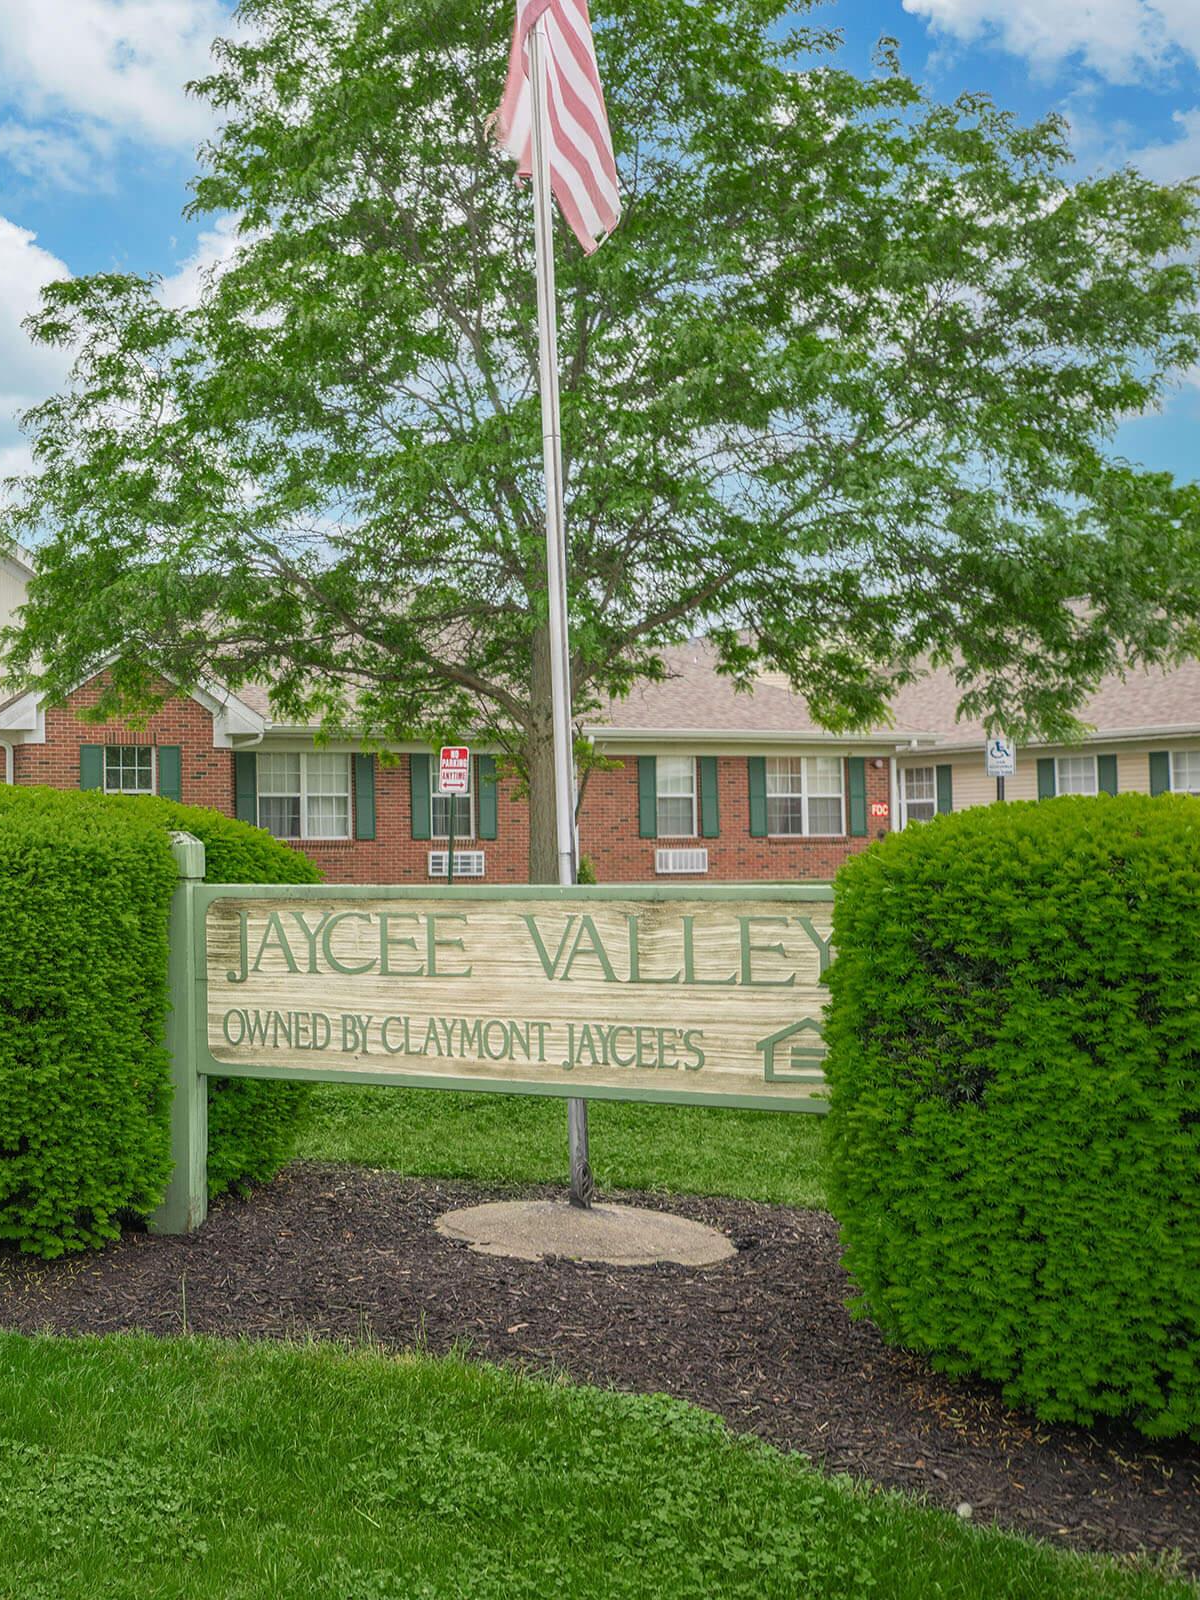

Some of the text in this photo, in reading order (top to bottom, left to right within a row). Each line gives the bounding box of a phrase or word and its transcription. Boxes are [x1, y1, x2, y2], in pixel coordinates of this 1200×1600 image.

[450, 750, 459, 758] NO
[441, 758, 467, 768] PARKING
[442, 772, 465, 780] ANYTIME
[872, 804, 888, 815] FDC
[226, 911, 835, 988] JAYCEE VALLEY
[223, 1008, 706, 1071] OWNED BY CLAYMONT JAYCEE'S
